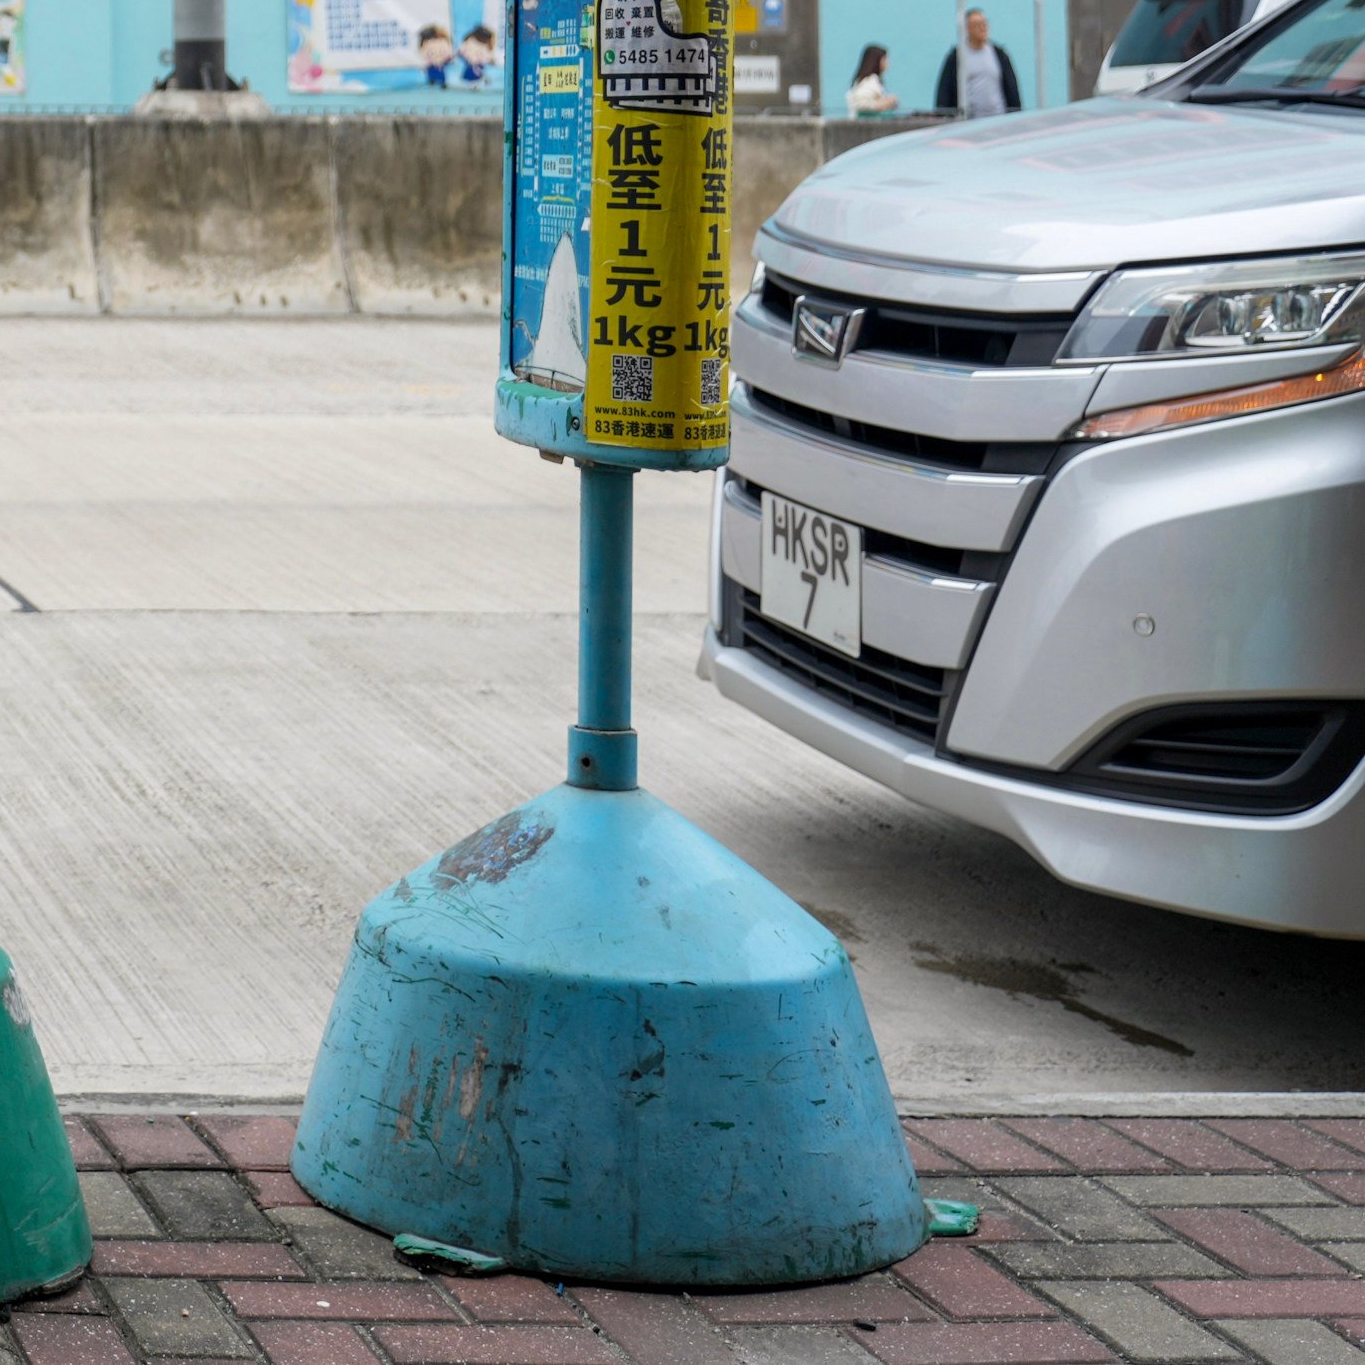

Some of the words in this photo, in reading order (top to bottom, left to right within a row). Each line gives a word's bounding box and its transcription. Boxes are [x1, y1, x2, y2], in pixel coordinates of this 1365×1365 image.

[605, 8, 625, 20] 回收
[619, 49, 659, 64] 5485
[665, 48, 705, 64] 1474
[606, 123, 663, 309] 低至1元
[697, 127, 728, 311] 低至1元
[594, 315, 677, 358] 1kg
[684, 320, 728, 359] 1kg
[595, 406, 676, 419] www.83hk.com
[595, 420, 674, 439] 83香港速運
[772, 499, 849, 587] HKSR
[801, 571, 818, 629] 7
